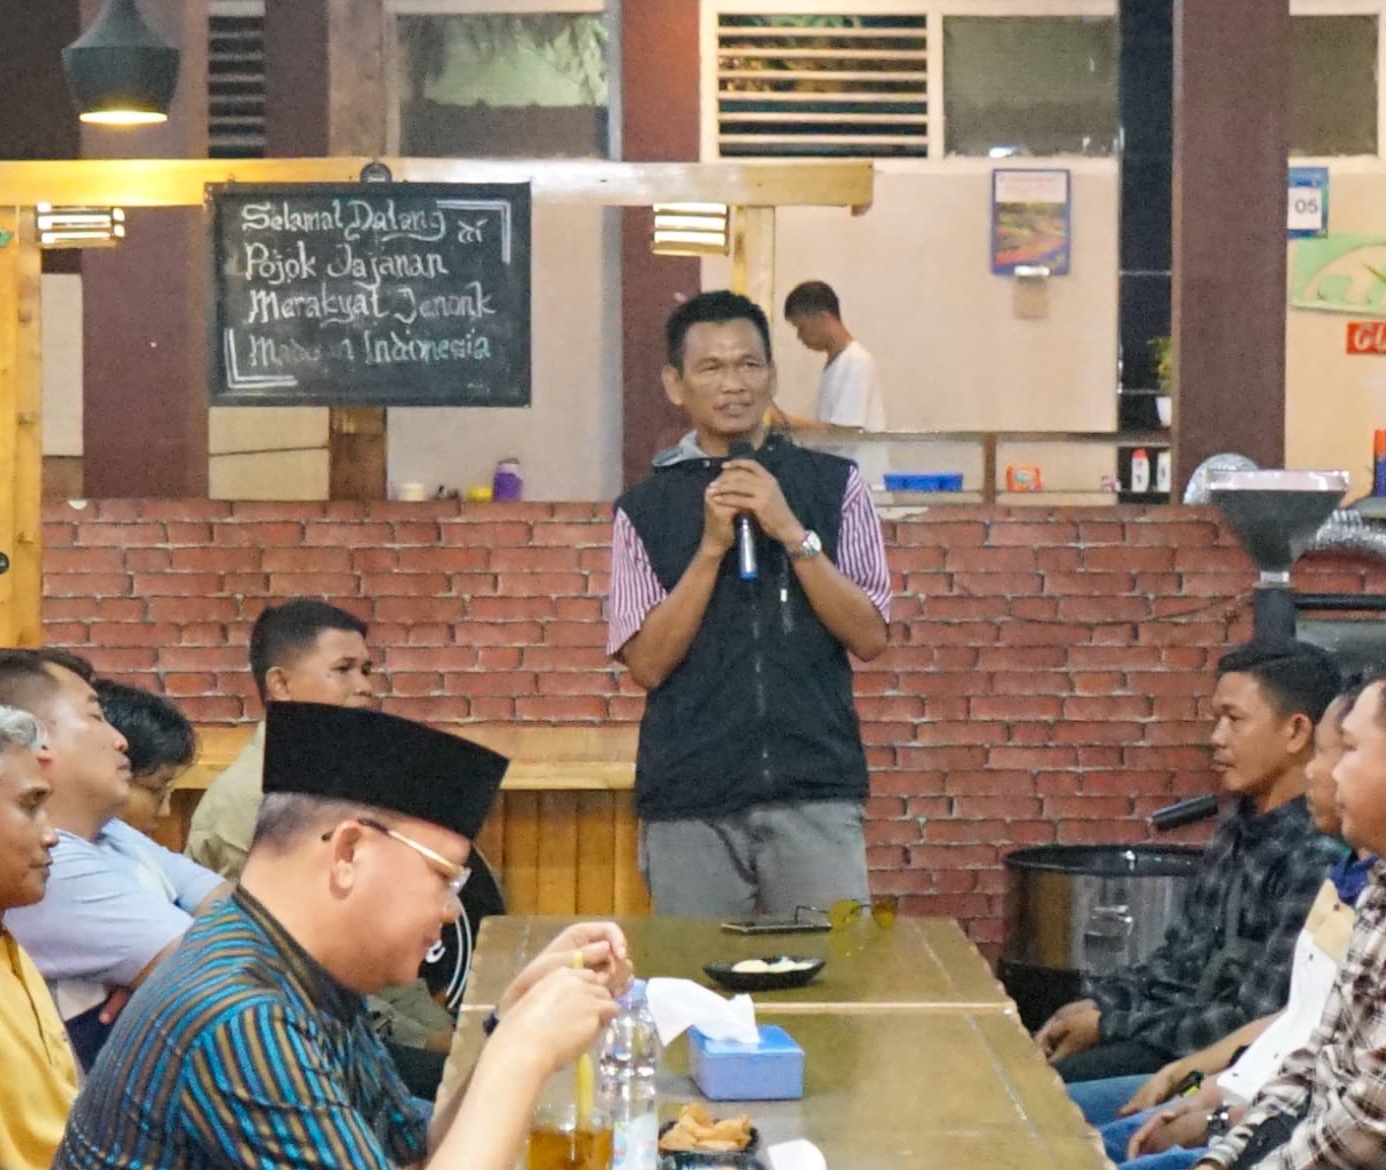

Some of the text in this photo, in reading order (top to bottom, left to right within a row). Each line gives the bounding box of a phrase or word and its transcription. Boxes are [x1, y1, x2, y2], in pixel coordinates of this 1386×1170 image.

[241, 200, 343, 232] Selamat
[1295, 198, 1318, 214] 05
[244, 241, 449, 289] Pojok Jajanan
